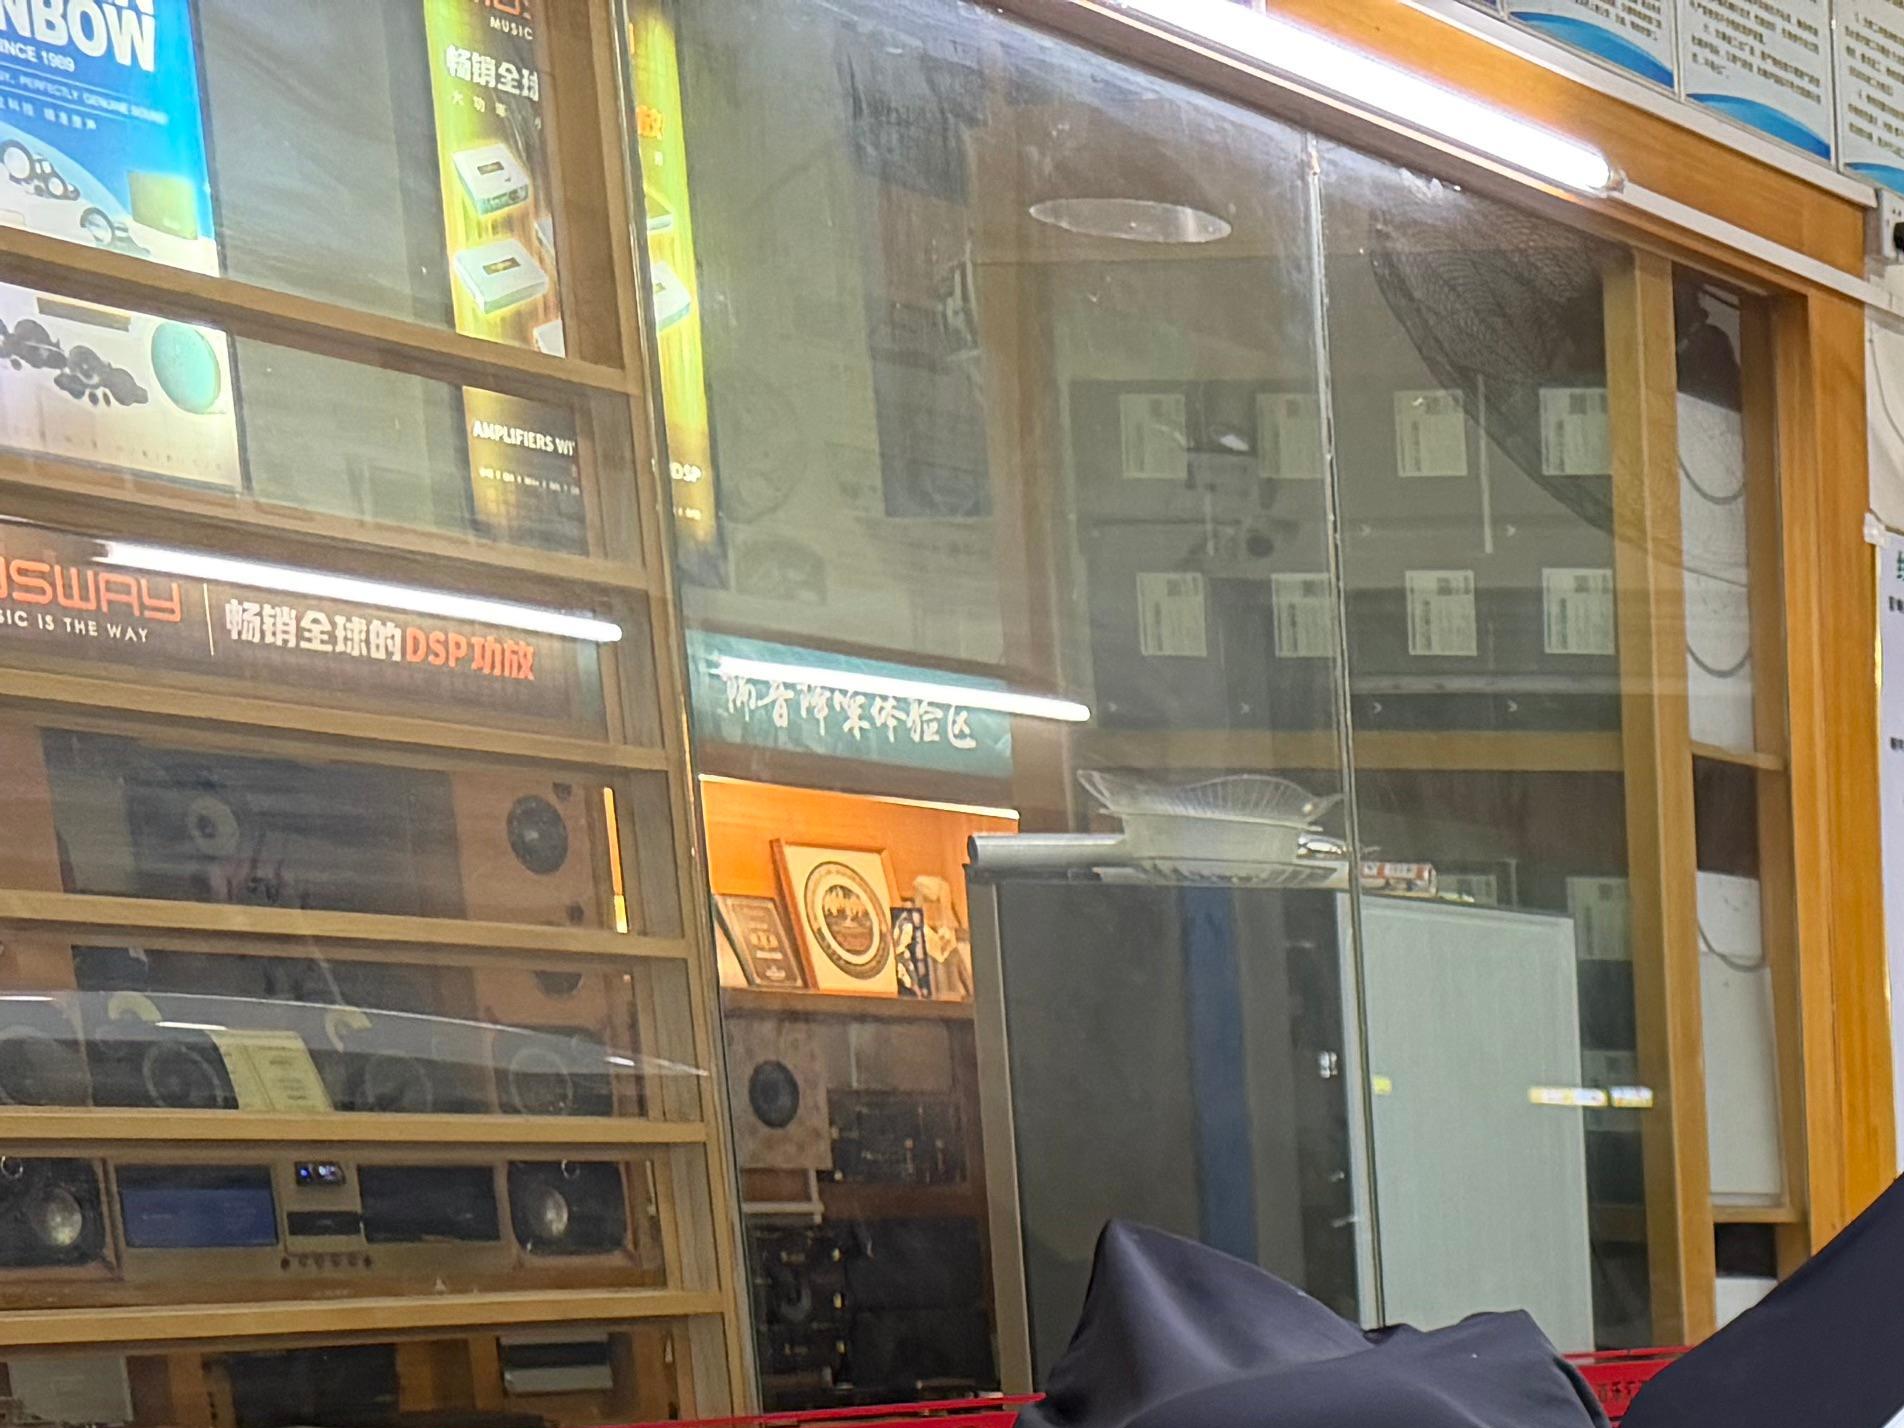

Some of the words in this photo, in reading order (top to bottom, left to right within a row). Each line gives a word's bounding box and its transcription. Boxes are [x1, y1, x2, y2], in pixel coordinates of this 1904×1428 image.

[472, 419, 555, 453] AMPLIFIERS
[0, 556, 182, 624] SWAY
[37, 614, 56, 632] IS
[63, 616, 100, 639] THE
[107, 623, 150, 646] WAY
[225, 598, 536, 682] 畅销全球的DSP功放
